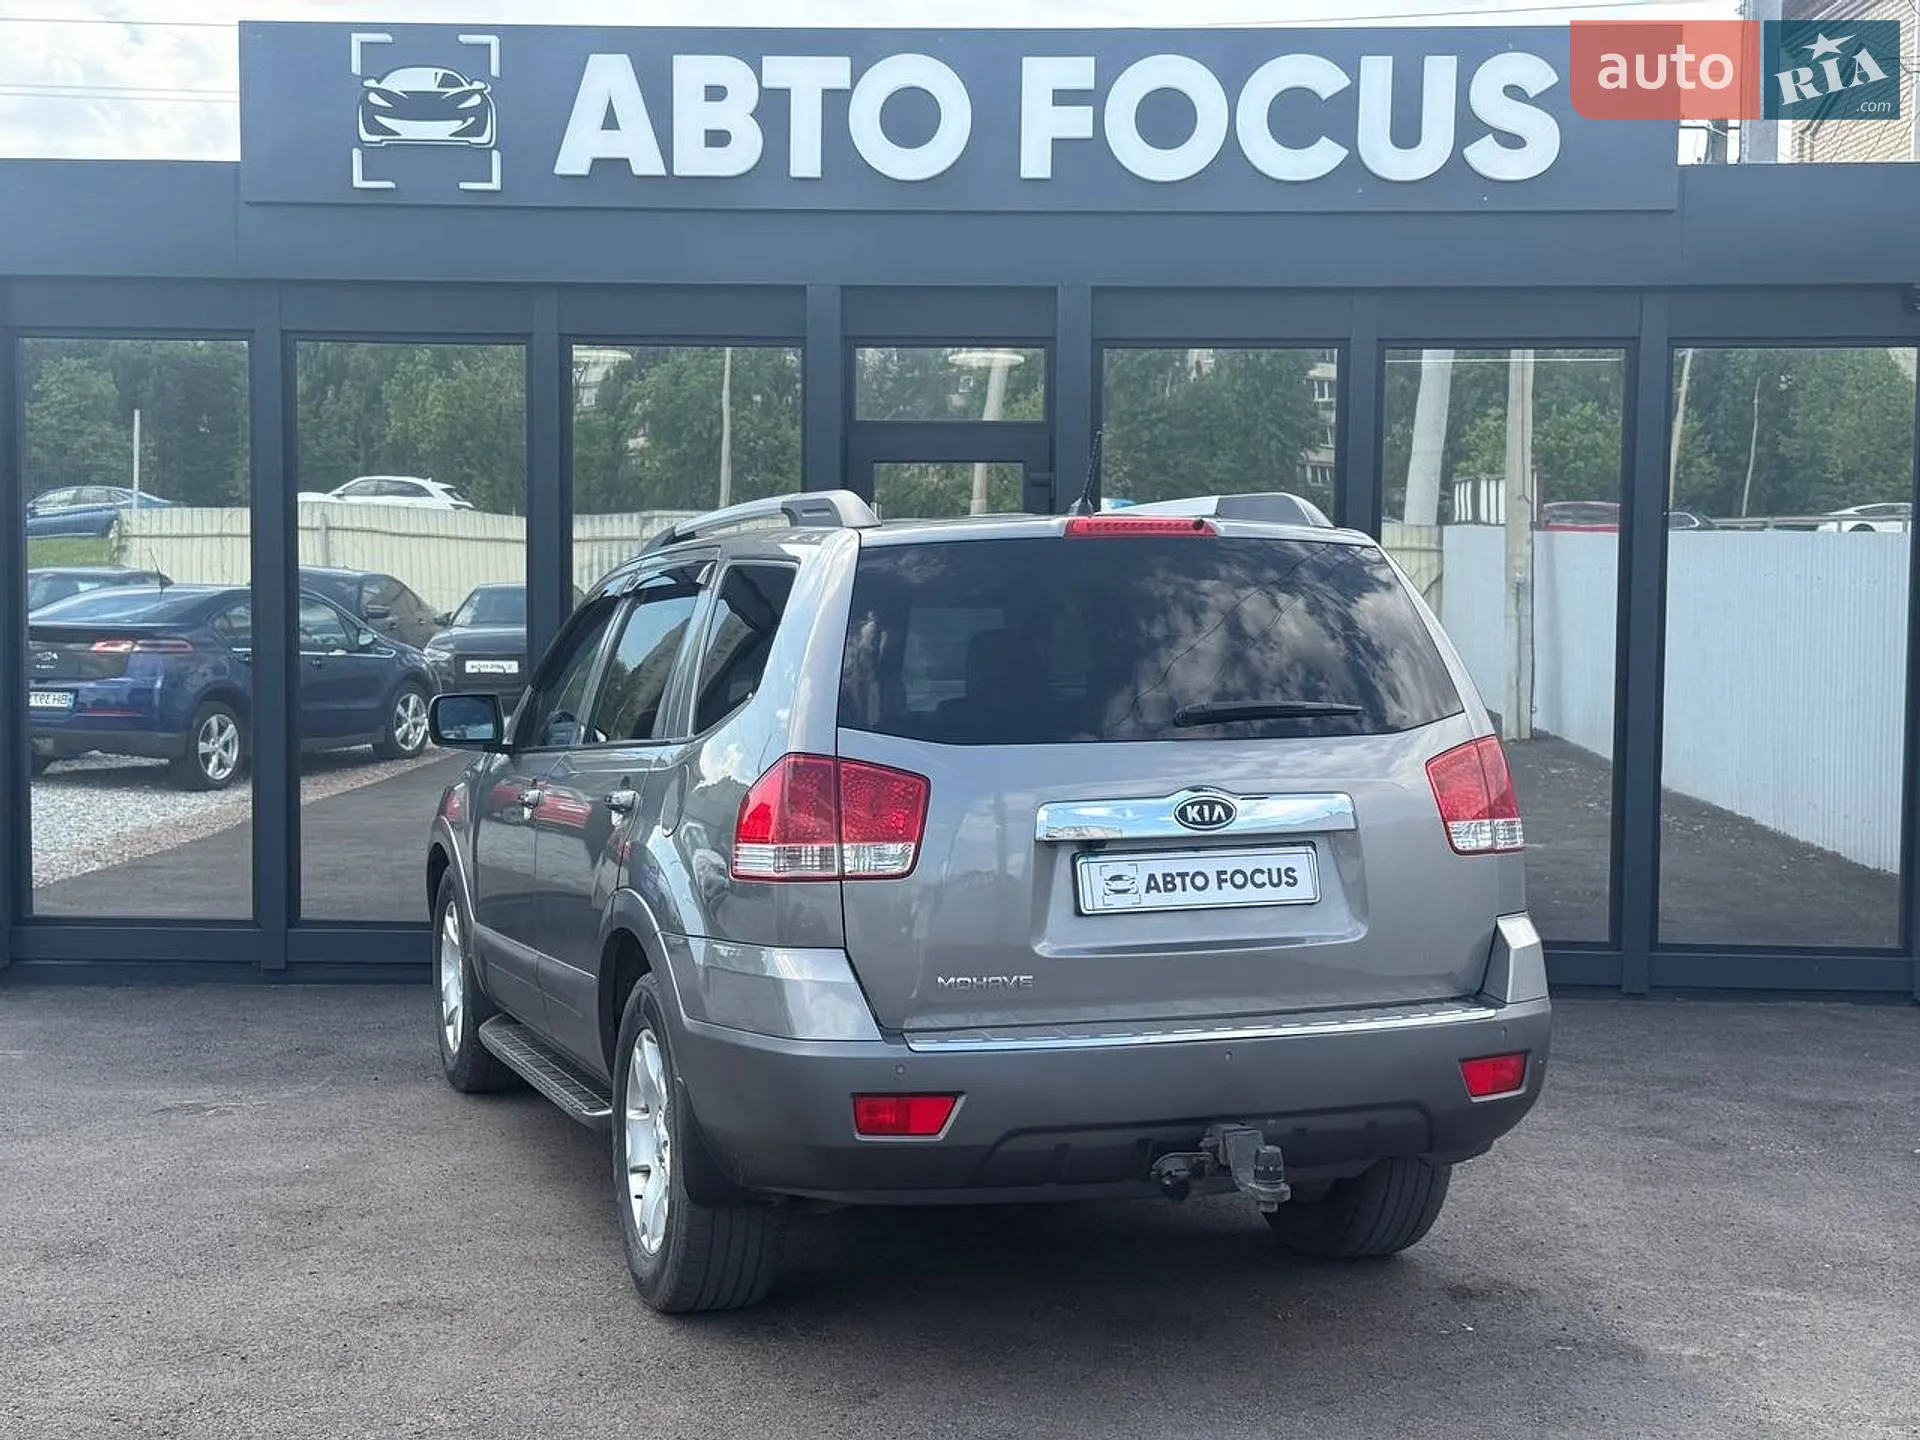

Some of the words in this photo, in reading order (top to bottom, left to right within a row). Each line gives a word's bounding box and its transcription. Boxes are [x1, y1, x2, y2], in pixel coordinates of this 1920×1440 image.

[553, 52, 973, 182] АВТО
[1019, 51, 1561, 182] FOCUS
[1185, 804, 1227, 823] KIA
[1143, 871, 1210, 895] АВТО
[1215, 866, 1299, 891] FOCUS
